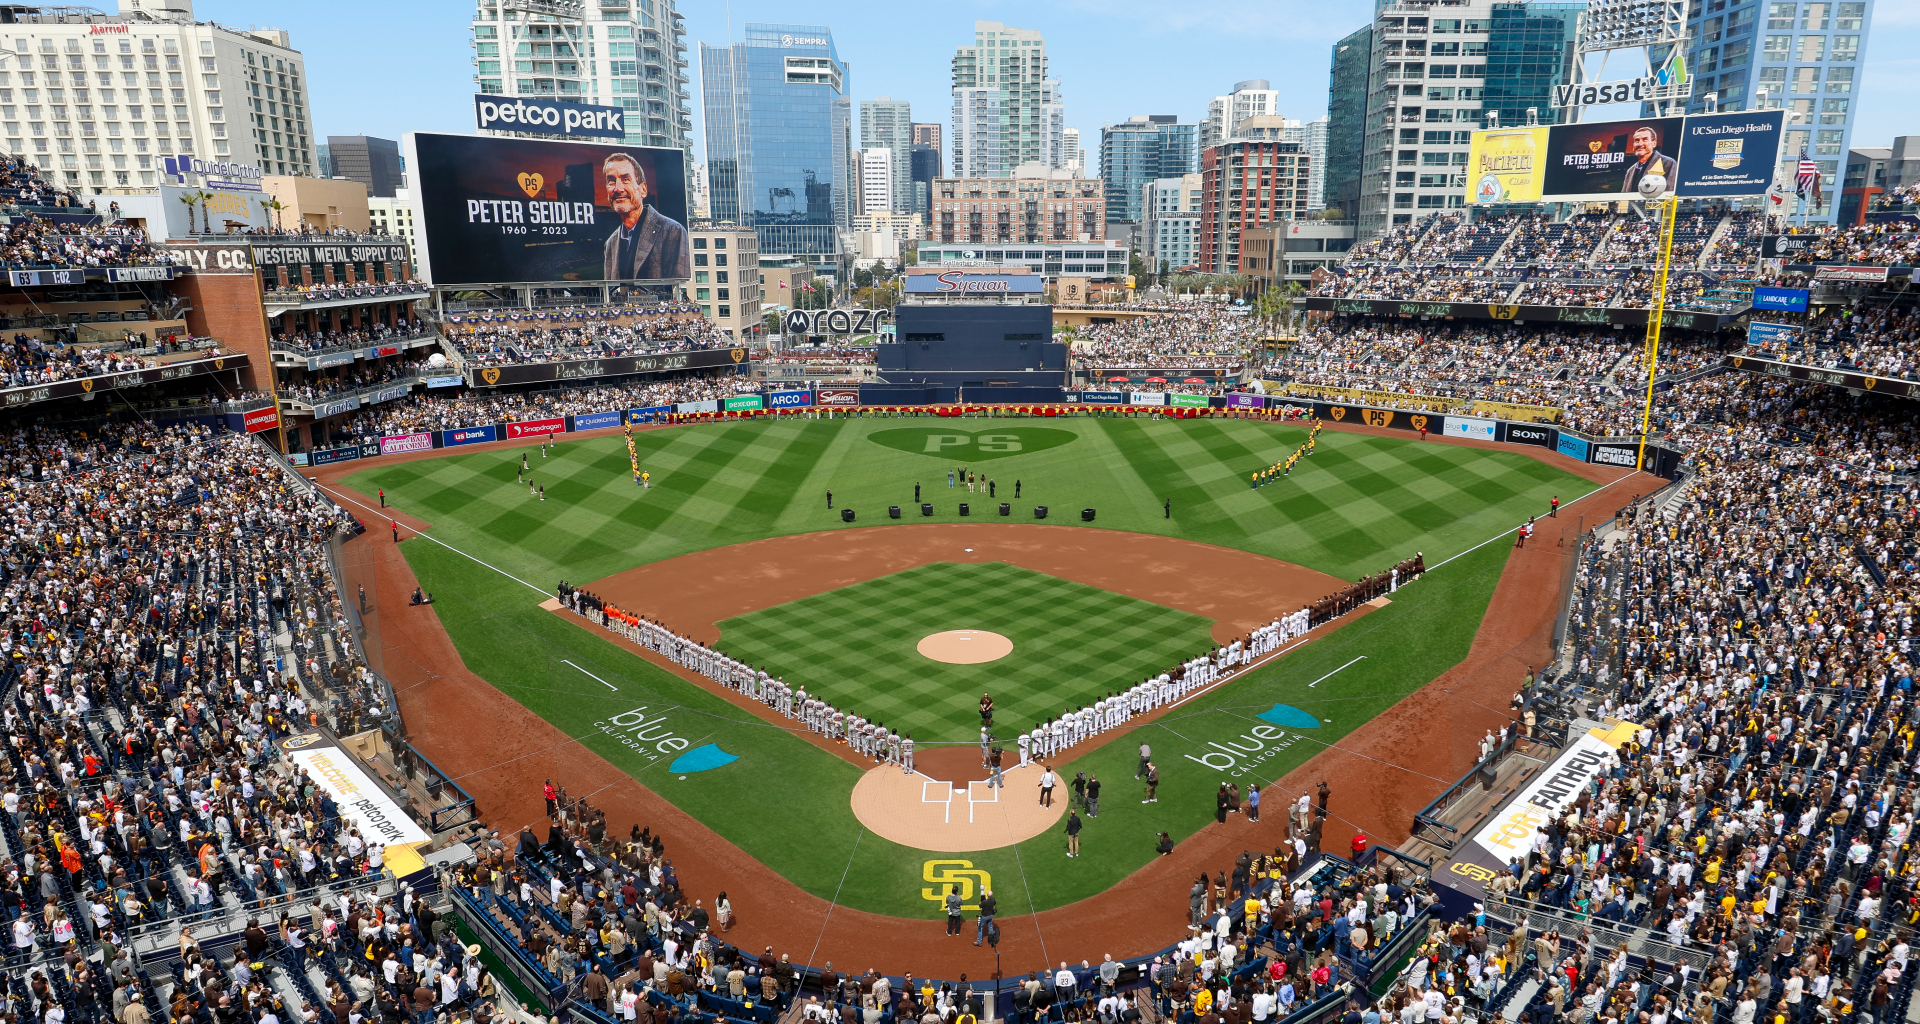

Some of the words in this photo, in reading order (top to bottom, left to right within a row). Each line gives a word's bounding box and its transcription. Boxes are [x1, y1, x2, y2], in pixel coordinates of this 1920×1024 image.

[89, 25, 128, 34] Marriott
[794, 38, 827, 46] SEMPRA
[1557, 78, 1643, 106] Viasat
[480, 100, 560, 127] petco
[564, 108, 622, 133] park
[1692, 126, 1706, 135] UC
[1706, 126, 1720, 135] San
[1722, 125, 1744, 134] Diego
[1746, 123, 1772, 132] Health
[1718, 140, 1741, 148] BEST
[1563, 154, 1589, 166] PETER
[1591, 152, 1624, 164] SEIDLER
[194, 159, 261, 178] QuidelOrtho
[525, 178, 538, 190] PS
[467, 200, 524, 223] PETER
[529, 201, 594, 224] SEIDLER
[502, 226, 527, 235] 1960
[542, 226, 567, 235] 2023
[1788, 240, 1807, 249] MRC
[217, 249, 252, 270] CO.
[253, 247, 310, 265] WESTERN
[315, 247, 350, 263] METAL
[352, 247, 387, 262] SUPPLY
[390, 246, 406, 261] CO.
[53, 271, 70, 284] 1:02
[936, 270, 1010, 297] Sycuan
[1069, 285, 1076, 293] 19
[1762, 296, 1787, 304] LANDCARE
[1399, 304, 1419, 313] 1960
[1426, 305, 1450, 315] 2023
[1496, 305, 1510, 318] PS
[814, 310, 888, 333] razr
[556, 366, 576, 379] Peter
[577, 362, 604, 377] Seidler
[635, 360, 656, 371] 1960
[664, 357, 687, 368] 2023
[487, 371, 496, 380] PS
[6, 393, 23, 405] 1960
[30, 388, 49, 400] 2023
[772, 395, 800, 405] ARCO
[820, 391, 854, 404] Sycuan
[324, 399, 352, 416] Canel's
[285, 417, 296, 428] 336
[585, 417, 618, 425] QuidelOrtho
[1370, 410, 1385, 426] PS
[524, 423, 562, 433] Snapdragon
[1512, 430, 1547, 440] SONY
[383, 441, 430, 453] CALIFORNIA
[923, 434, 1022, 452] PS
[1560, 439, 1576, 451] petco
[317, 451, 356, 460] AGRAMONT
[363, 445, 377, 456] 342
[1595, 452, 1637, 465] HOMERS
[608, 706, 689, 754] blue
[594, 721, 658, 761] CALIFORNIA
[1184, 725, 1285, 772] blue
[1230, 734, 1302, 777] CALIFORNIA
[308, 752, 359, 795] WELCOME
[350, 798, 385, 825] petco
[370, 820, 406, 842] park
[1488, 813, 1542, 850] FOR
[1527, 749, 1608, 810] FAITHFUL
[922, 860, 991, 911] SD
